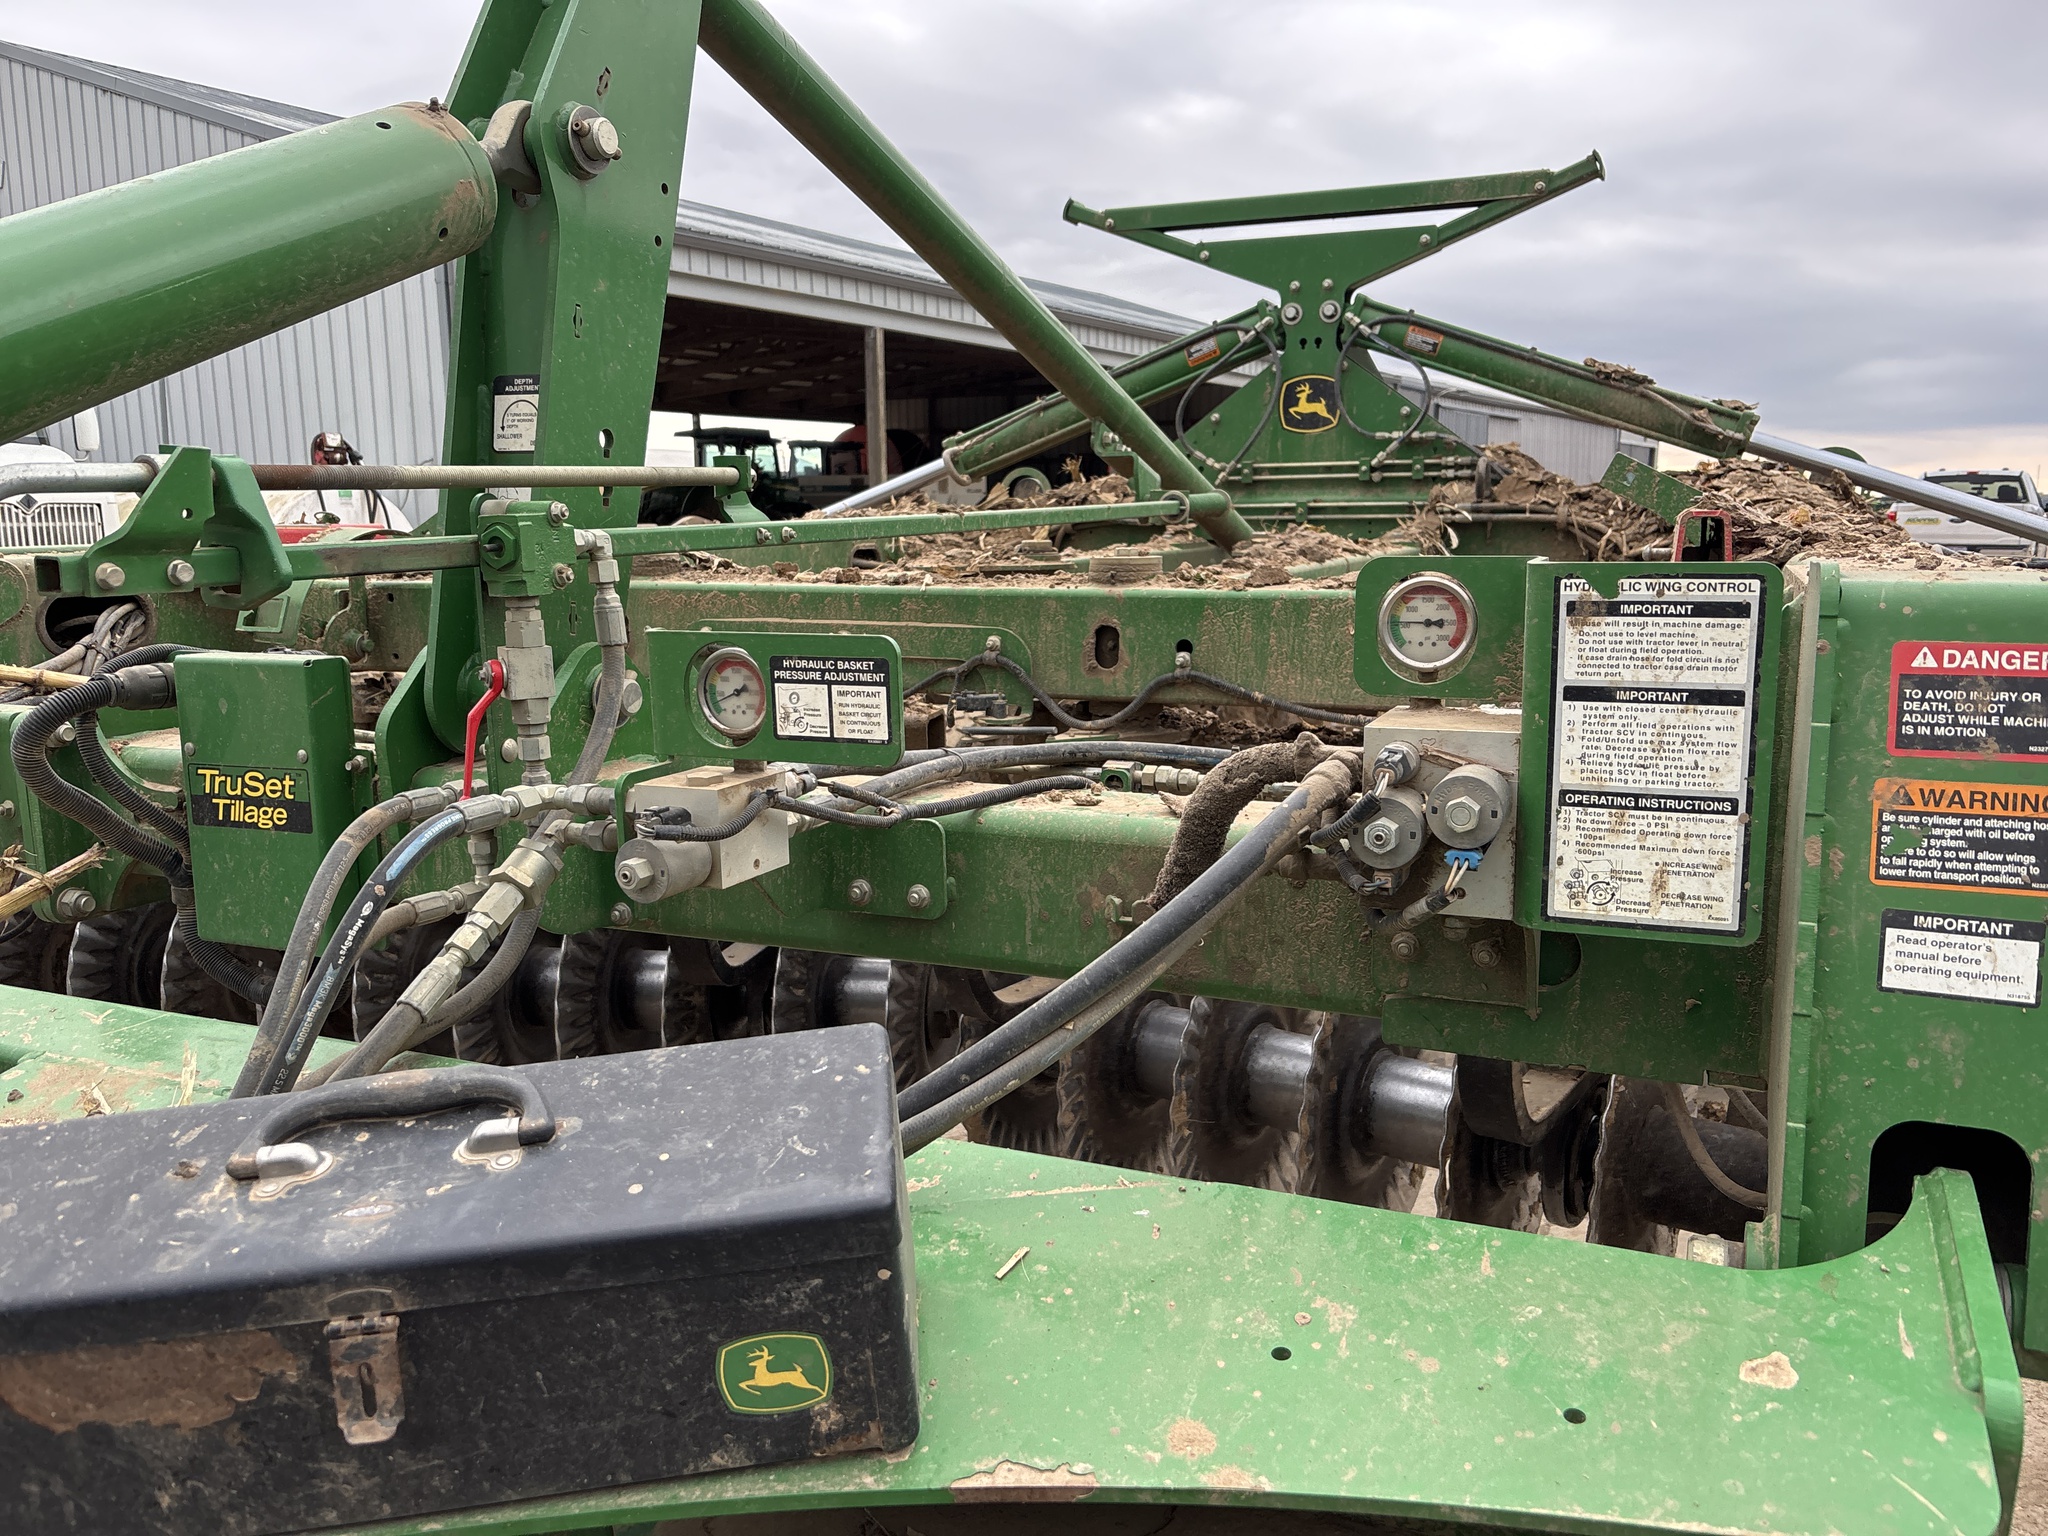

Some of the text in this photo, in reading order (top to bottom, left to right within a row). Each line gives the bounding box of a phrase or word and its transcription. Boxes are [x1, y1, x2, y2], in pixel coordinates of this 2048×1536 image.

[1564, 582, 1756, 593] HYDLIC WING CONTROL
[1621, 605, 1694, 615] IMPORTANT
[1705, 622, 1745, 630] damage:
[783, 660, 874, 670] HYDRAULIC BASKET
[774, 671, 885, 682] PRESSURE ADJUSTMENT
[837, 690, 881, 699] IMPORTANT
[1617, 691, 1689, 702] IMPORTANT
[1904, 689, 2042, 703] TO AVOID INJURY OR
[1904, 701, 2006, 714] DEATH, DO NOT
[1902, 713, 1955, 724] ADJUST
[1958, 715, 2000, 726] WHILE
[1902, 725, 1987, 737] IS IN MOTION
[197, 769, 295, 800] TruSet
[1566, 794, 1732, 812] OPERATING INSTRUCTIONS
[212, 798, 288, 829] Tillage
[1576, 809, 1605, 817] Tractor
[1676, 816, 1728, 824] continuous.
[1883, 813, 1896, 822] Be
[1898, 814, 1919, 823] sure
[1922, 815, 1962, 827] cylinder
[1964, 817, 1983, 827] and
[1985, 818, 2032, 831] attaching
[1575, 833, 1606, 841] -100psi
[1965, 829, 1986, 838] with
[1989, 830, 2001, 839] oil
[2003, 831, 2035, 841] before
[1575, 841, 1636, 851] Recommended
[1639, 845, 1679, 854] Maximum
[1682, 847, 1705, 855] down
[1930, 838, 1969, 848] system.
[1916, 849, 1926, 857] to
[1929, 848, 1942, 858] do
[1944, 850, 1957, 859] so
[1958, 850, 1975, 860] will
[1977, 851, 2003, 862] allow
[2006, 853, 2036, 865] wings
[1662, 862, 1700, 870] INCREASE
[1880, 856, 2040, 876] to fall rapidly when attempting to
[1610, 875, 1644, 883] Pressure
[1662, 870, 1715, 878] PENETRATION
[1880, 866, 2024, 885] lower from transport position.
[1616, 899, 1651, 907] Decrease
[1661, 893, 1724, 903] DECREASE WING
[1616, 906, 1650, 914] Pressure
[1660, 901, 1713, 910] PENETRATION
[1913, 915, 2014, 936] IMPORTANT
[1896, 934, 1993, 953] Read operator's
[1896, 950, 1982, 966] manual before
[1894, 963, 2024, 985] operating equipment.
[318, 976, 335, 1002] 8M3K
